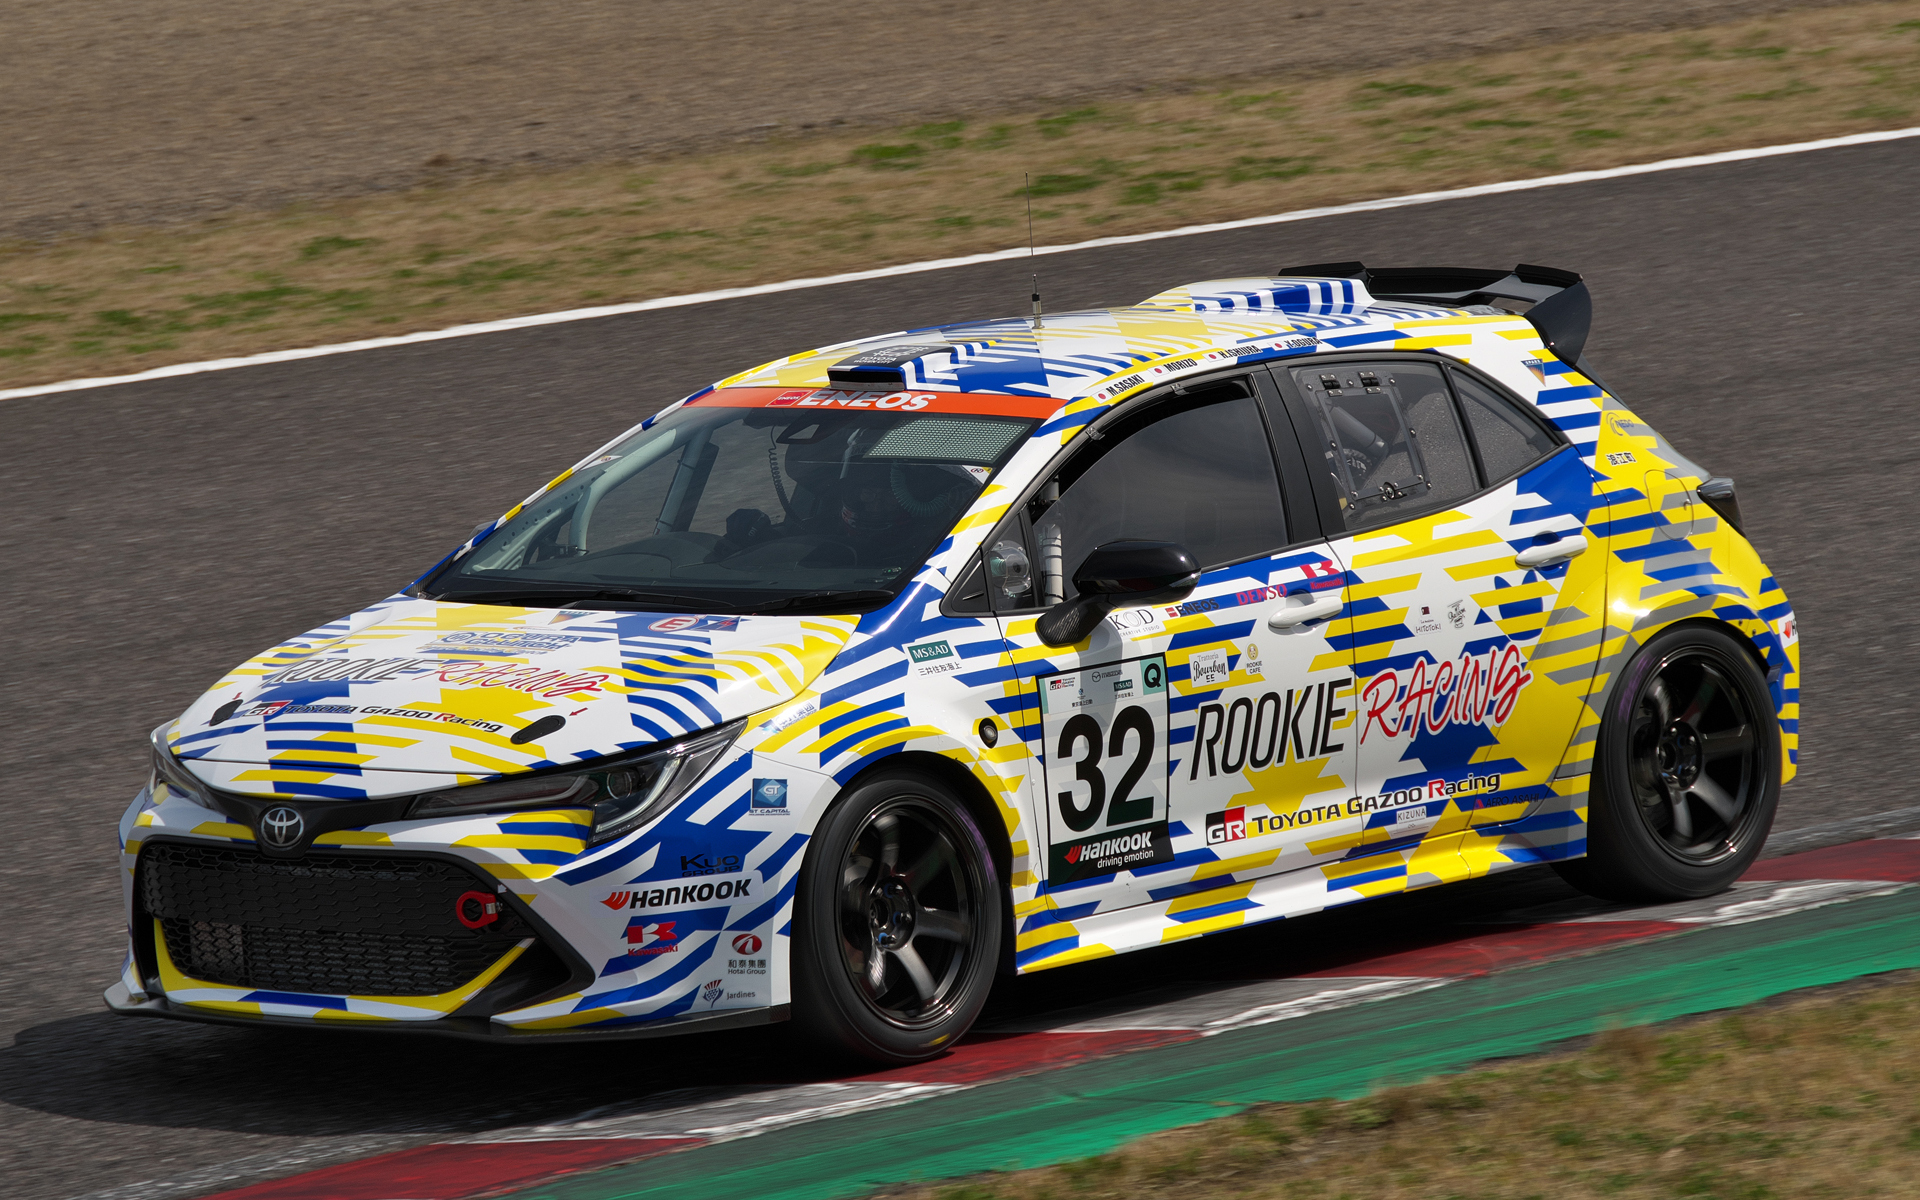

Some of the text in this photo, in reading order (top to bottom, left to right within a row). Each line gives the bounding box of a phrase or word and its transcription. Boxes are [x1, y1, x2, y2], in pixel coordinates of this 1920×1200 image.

[1218, 344, 1263, 358] H.ISHIURA
[1284, 336, 1322, 348] Y.OGURA
[1163, 358, 1198, 372] MORIZO
[1106, 374, 1146, 396] M.SASAKI
[797, 390, 937, 410] ENEOS
[1310, 577, 1344, 590] Kawasaki
[1236, 584, 1288, 606] DENSO
[1176, 598, 1220, 617] ENEOS
[1108, 608, 1154, 630] KOD
[912, 644, 949, 658] MS&AD
[1193, 660, 1226, 682] Bourbon
[1246, 660, 1262, 668] ROOKIE
[259, 658, 608, 696] ROOKIE RACING
[1144, 662, 1161, 688] Q
[284, 704, 357, 714] TOYOTA
[360, 706, 432, 719] GAZOO
[433, 712, 502, 732] Racing
[1190, 644, 1532, 780] ROOKIE RACING
[1058, 705, 1155, 832] 32
[764, 785, 781, 795] GT
[1207, 773, 1501, 844] GR TOYOTA GAZOO Racing
[1486, 793, 1540, 808] AERO ASAHI
[1398, 807, 1426, 821] KIZUNA
[1097, 850, 1154, 868] driving emotion
[682, 864, 740, 878] GROUP
[628, 943, 678, 956] Kawasaki
